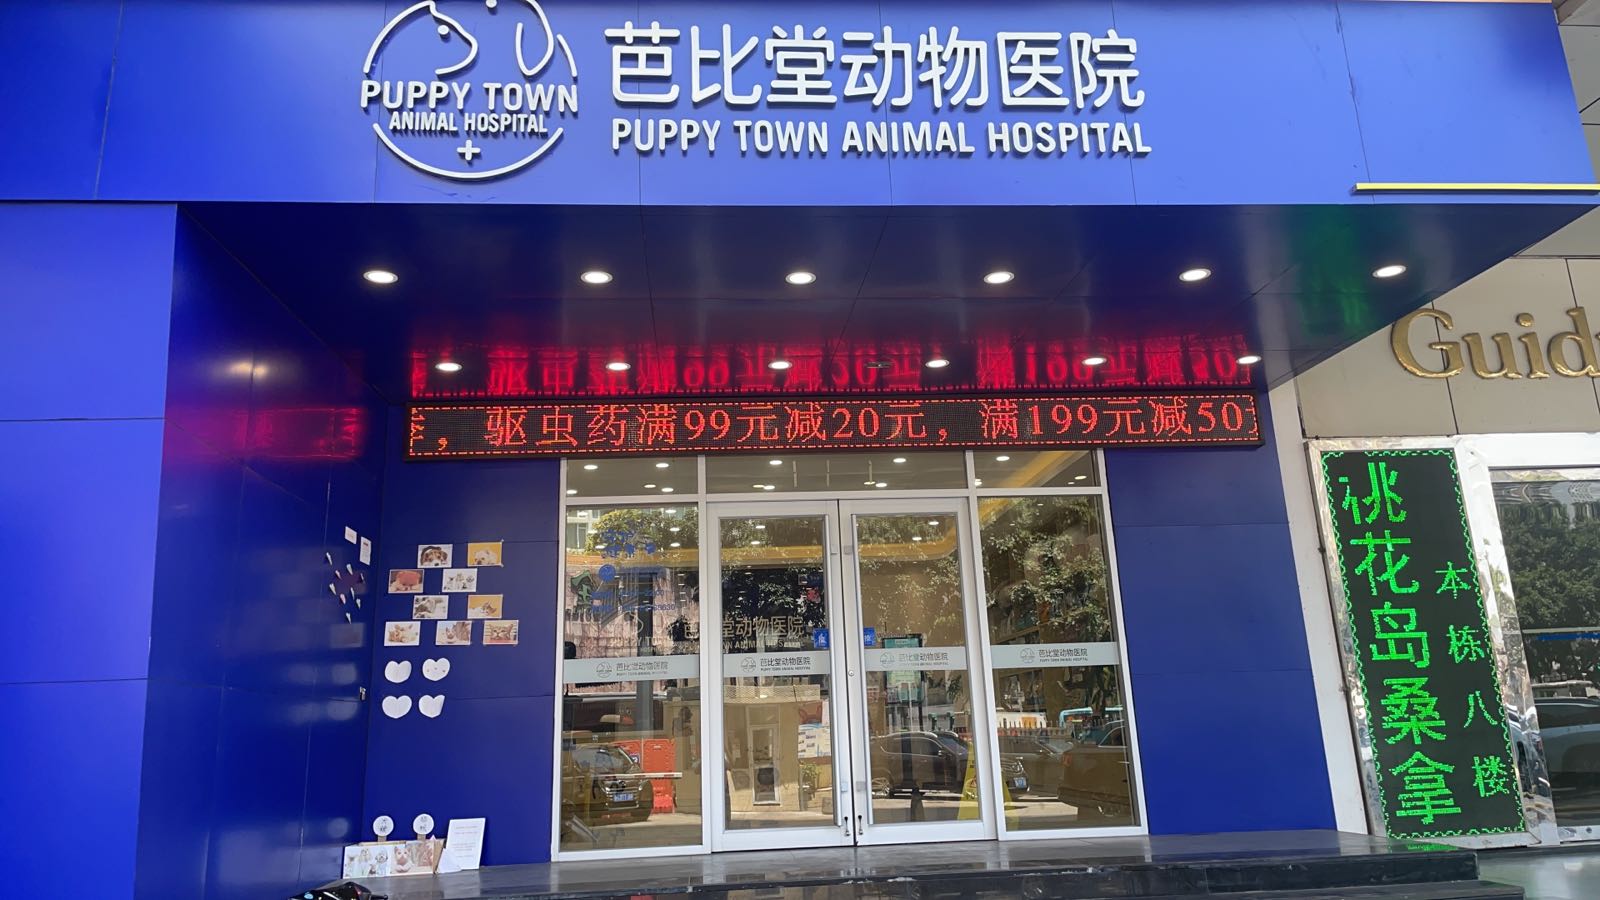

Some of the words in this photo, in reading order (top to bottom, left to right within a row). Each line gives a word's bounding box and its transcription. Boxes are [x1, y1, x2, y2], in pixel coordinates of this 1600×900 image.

[360, 80, 471, 110] PUPPY
[483, 82, 578, 113] TOWN
[604, 21, 1145, 109] 芭比堂动物医院
[389, 111, 458, 131] ANIMAL
[464, 112, 548, 133] HOSPITAL
[612, 118, 720, 151] PUPPY
[733, 120, 828, 153] TOWN
[842, 121, 975, 153] ANIMAL
[988, 122, 1152, 154] HOSPITAL
[1391, 306, 1600, 379] Guid
[411, 396, 1257, 450] ，驱虫药满99元减20元，满199元减50
[1339, 461, 1461, 824] 桃花岛桑拿
[1435, 562, 1509, 797] 本栋八楼
